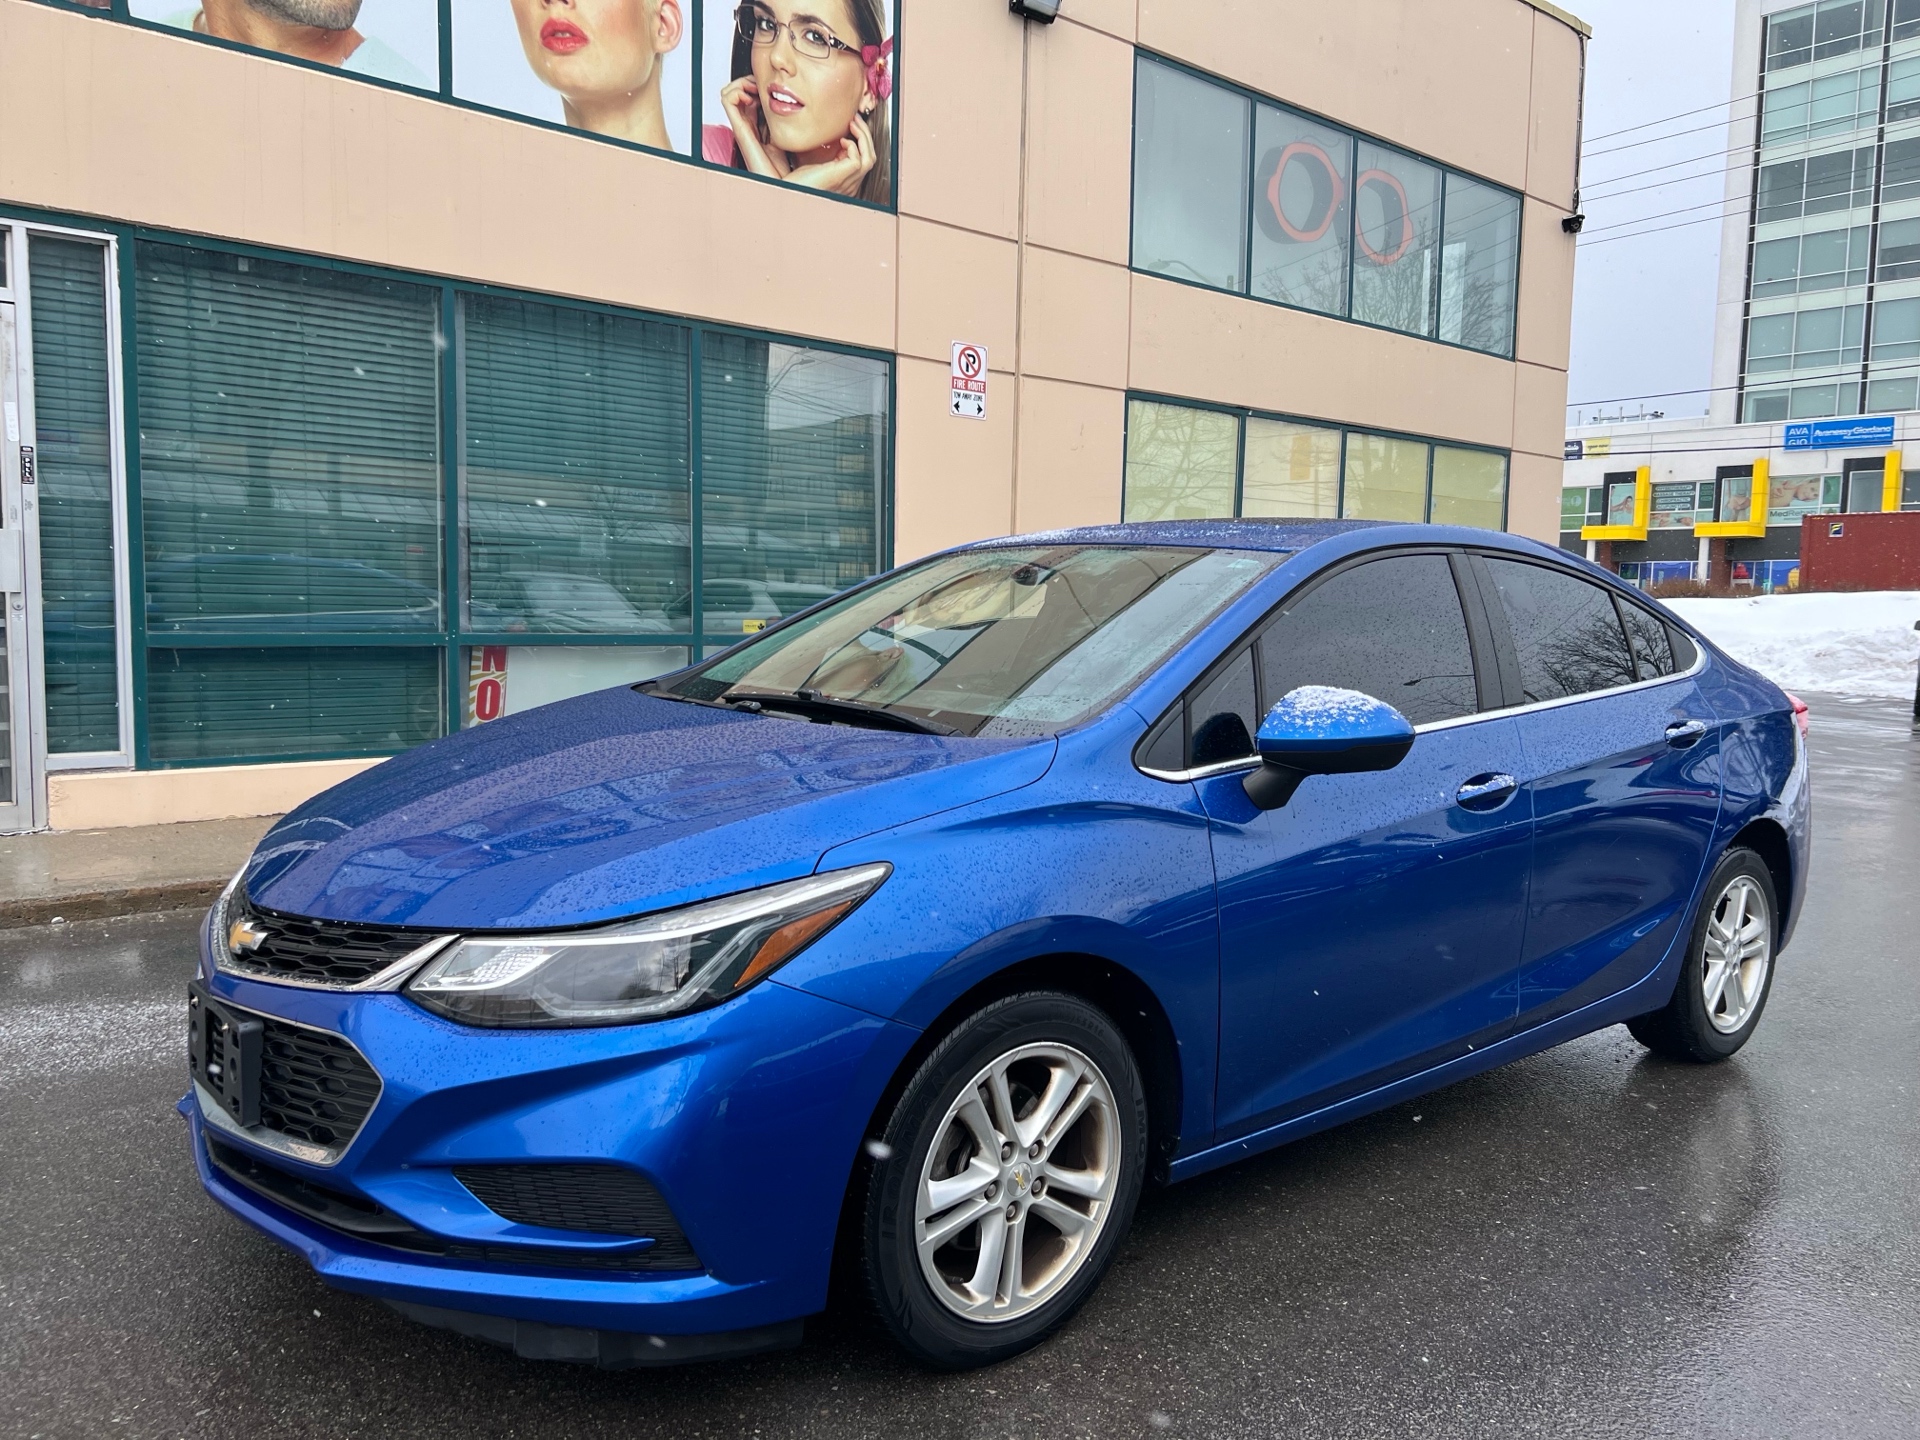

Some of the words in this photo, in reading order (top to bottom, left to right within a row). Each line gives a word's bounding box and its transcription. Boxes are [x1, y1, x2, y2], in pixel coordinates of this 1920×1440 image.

[954, 379, 966, 390] FIRE
[967, 381, 984, 392] ROUTE
[953, 391, 961, 399] TOW
[962, 392, 972, 401] AWAY
[973, 394, 983, 402] ZONE
[1788, 439, 1808, 447] GIO
